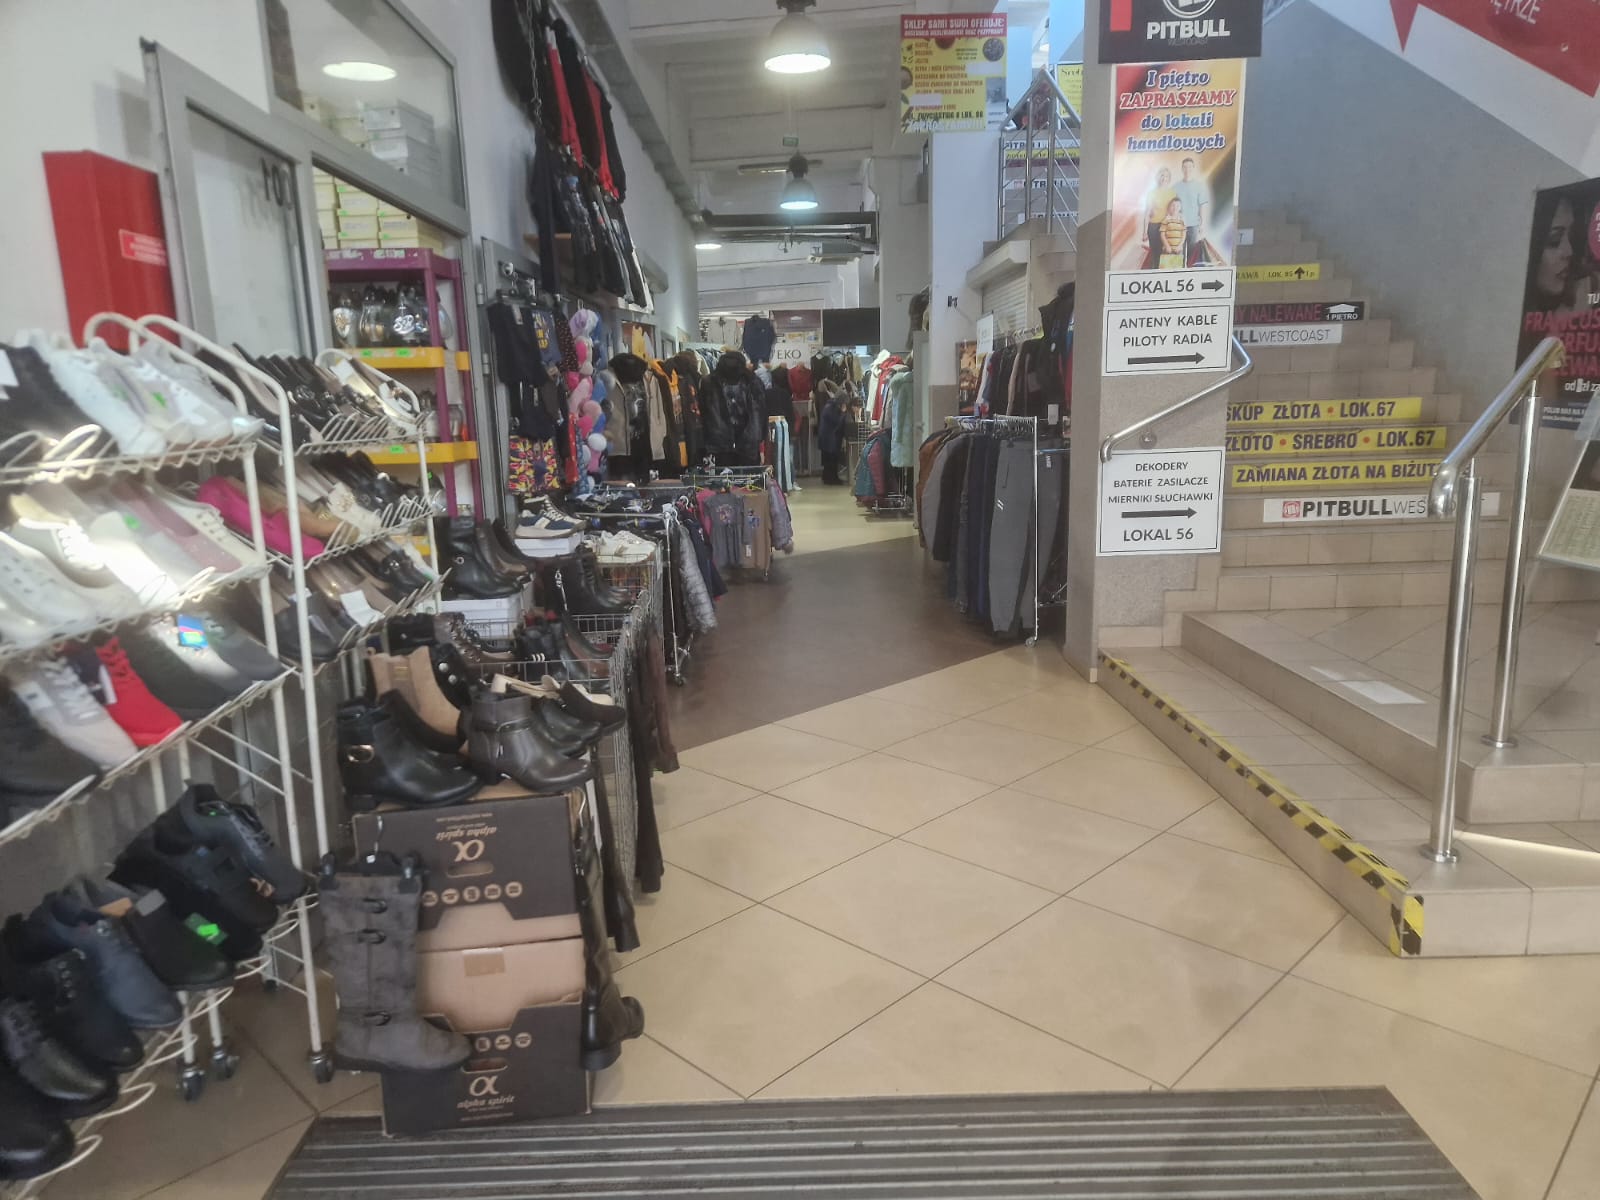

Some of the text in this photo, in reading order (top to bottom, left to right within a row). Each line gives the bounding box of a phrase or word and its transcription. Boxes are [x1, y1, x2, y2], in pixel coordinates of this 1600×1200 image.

[1146, 19, 1231, 40] PITBULL
[1145, 70, 1210, 89] I piętro
[1120, 90, 1237, 110] ZAPRASZAMY
[1141, 111, 1214, 129] do lokali
[1127, 132, 1225, 152] handlowych
[1121, 279, 1195, 295] LOKAL 56
[1119, 314, 1218, 329] ANTENY KABLE
[1250, 304, 1323, 322] NALEWANE
[1123, 333, 1213, 347] PILOTY RADIA
[1272, 403, 1321, 420] ZŁOTA
[1339, 401, 1396, 418] LOK.67
[1226, 430, 1436, 452] ZŁOTO SREBRO LOK.67
[1135, 461, 1189, 472] DEKODERY
[1236, 460, 1437, 483] ZAMIANA ZŁOTA NA BIŻUT
[1113, 476, 1209, 488] BATERIE ZASILACZE
[1108, 492, 1213, 504] MIERNIKI SŁUCHAWKI
[1302, 498, 1393, 518] PITBULL
[1123, 527, 1194, 542] LOKAL 56
